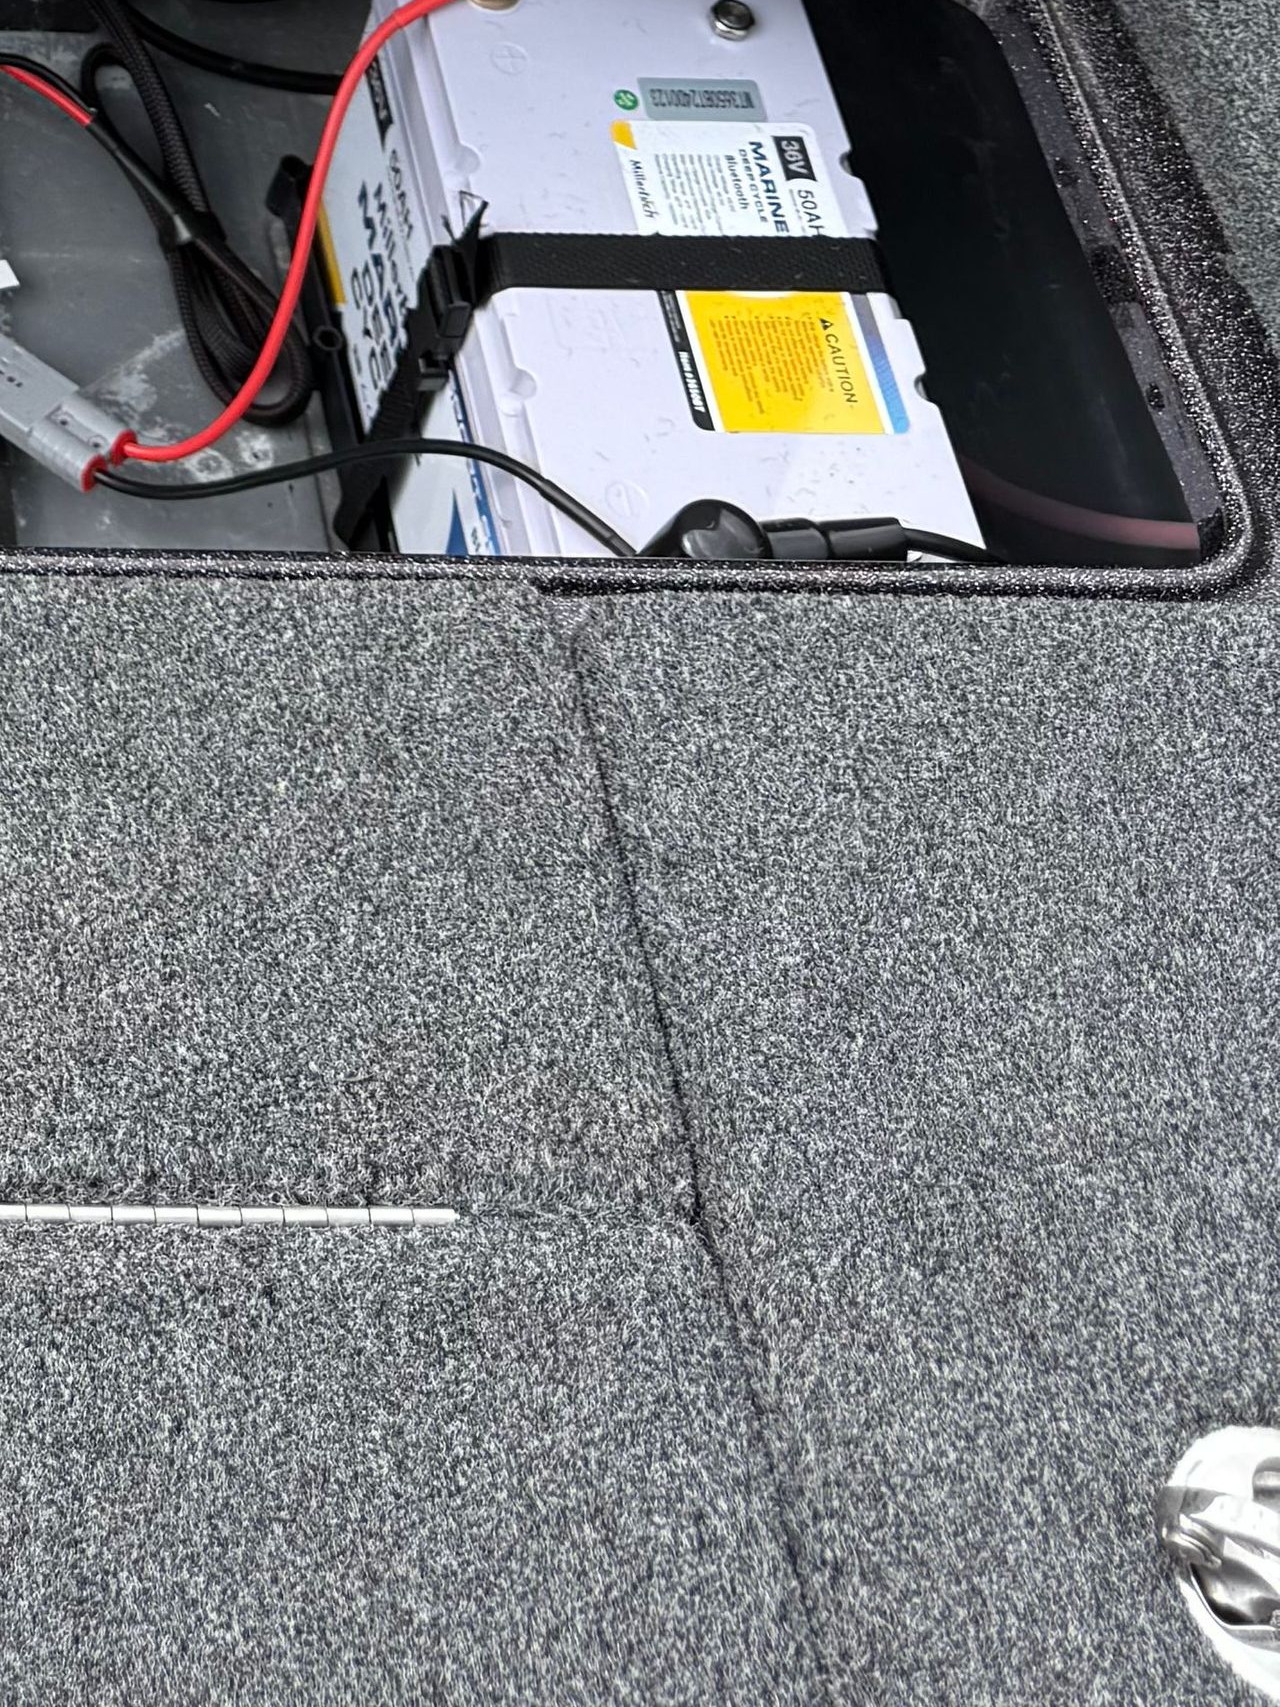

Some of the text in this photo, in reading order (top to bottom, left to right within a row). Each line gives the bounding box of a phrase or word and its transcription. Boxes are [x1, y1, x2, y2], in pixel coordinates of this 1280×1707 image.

[724, 154, 750, 210] Bluetooth
[738, 149, 769, 223] DEEP CYCLE
[748, 141, 790, 234] MARINE
[781, 140, 808, 175] 36V
[824, 333, 859, 404] CAUTION
